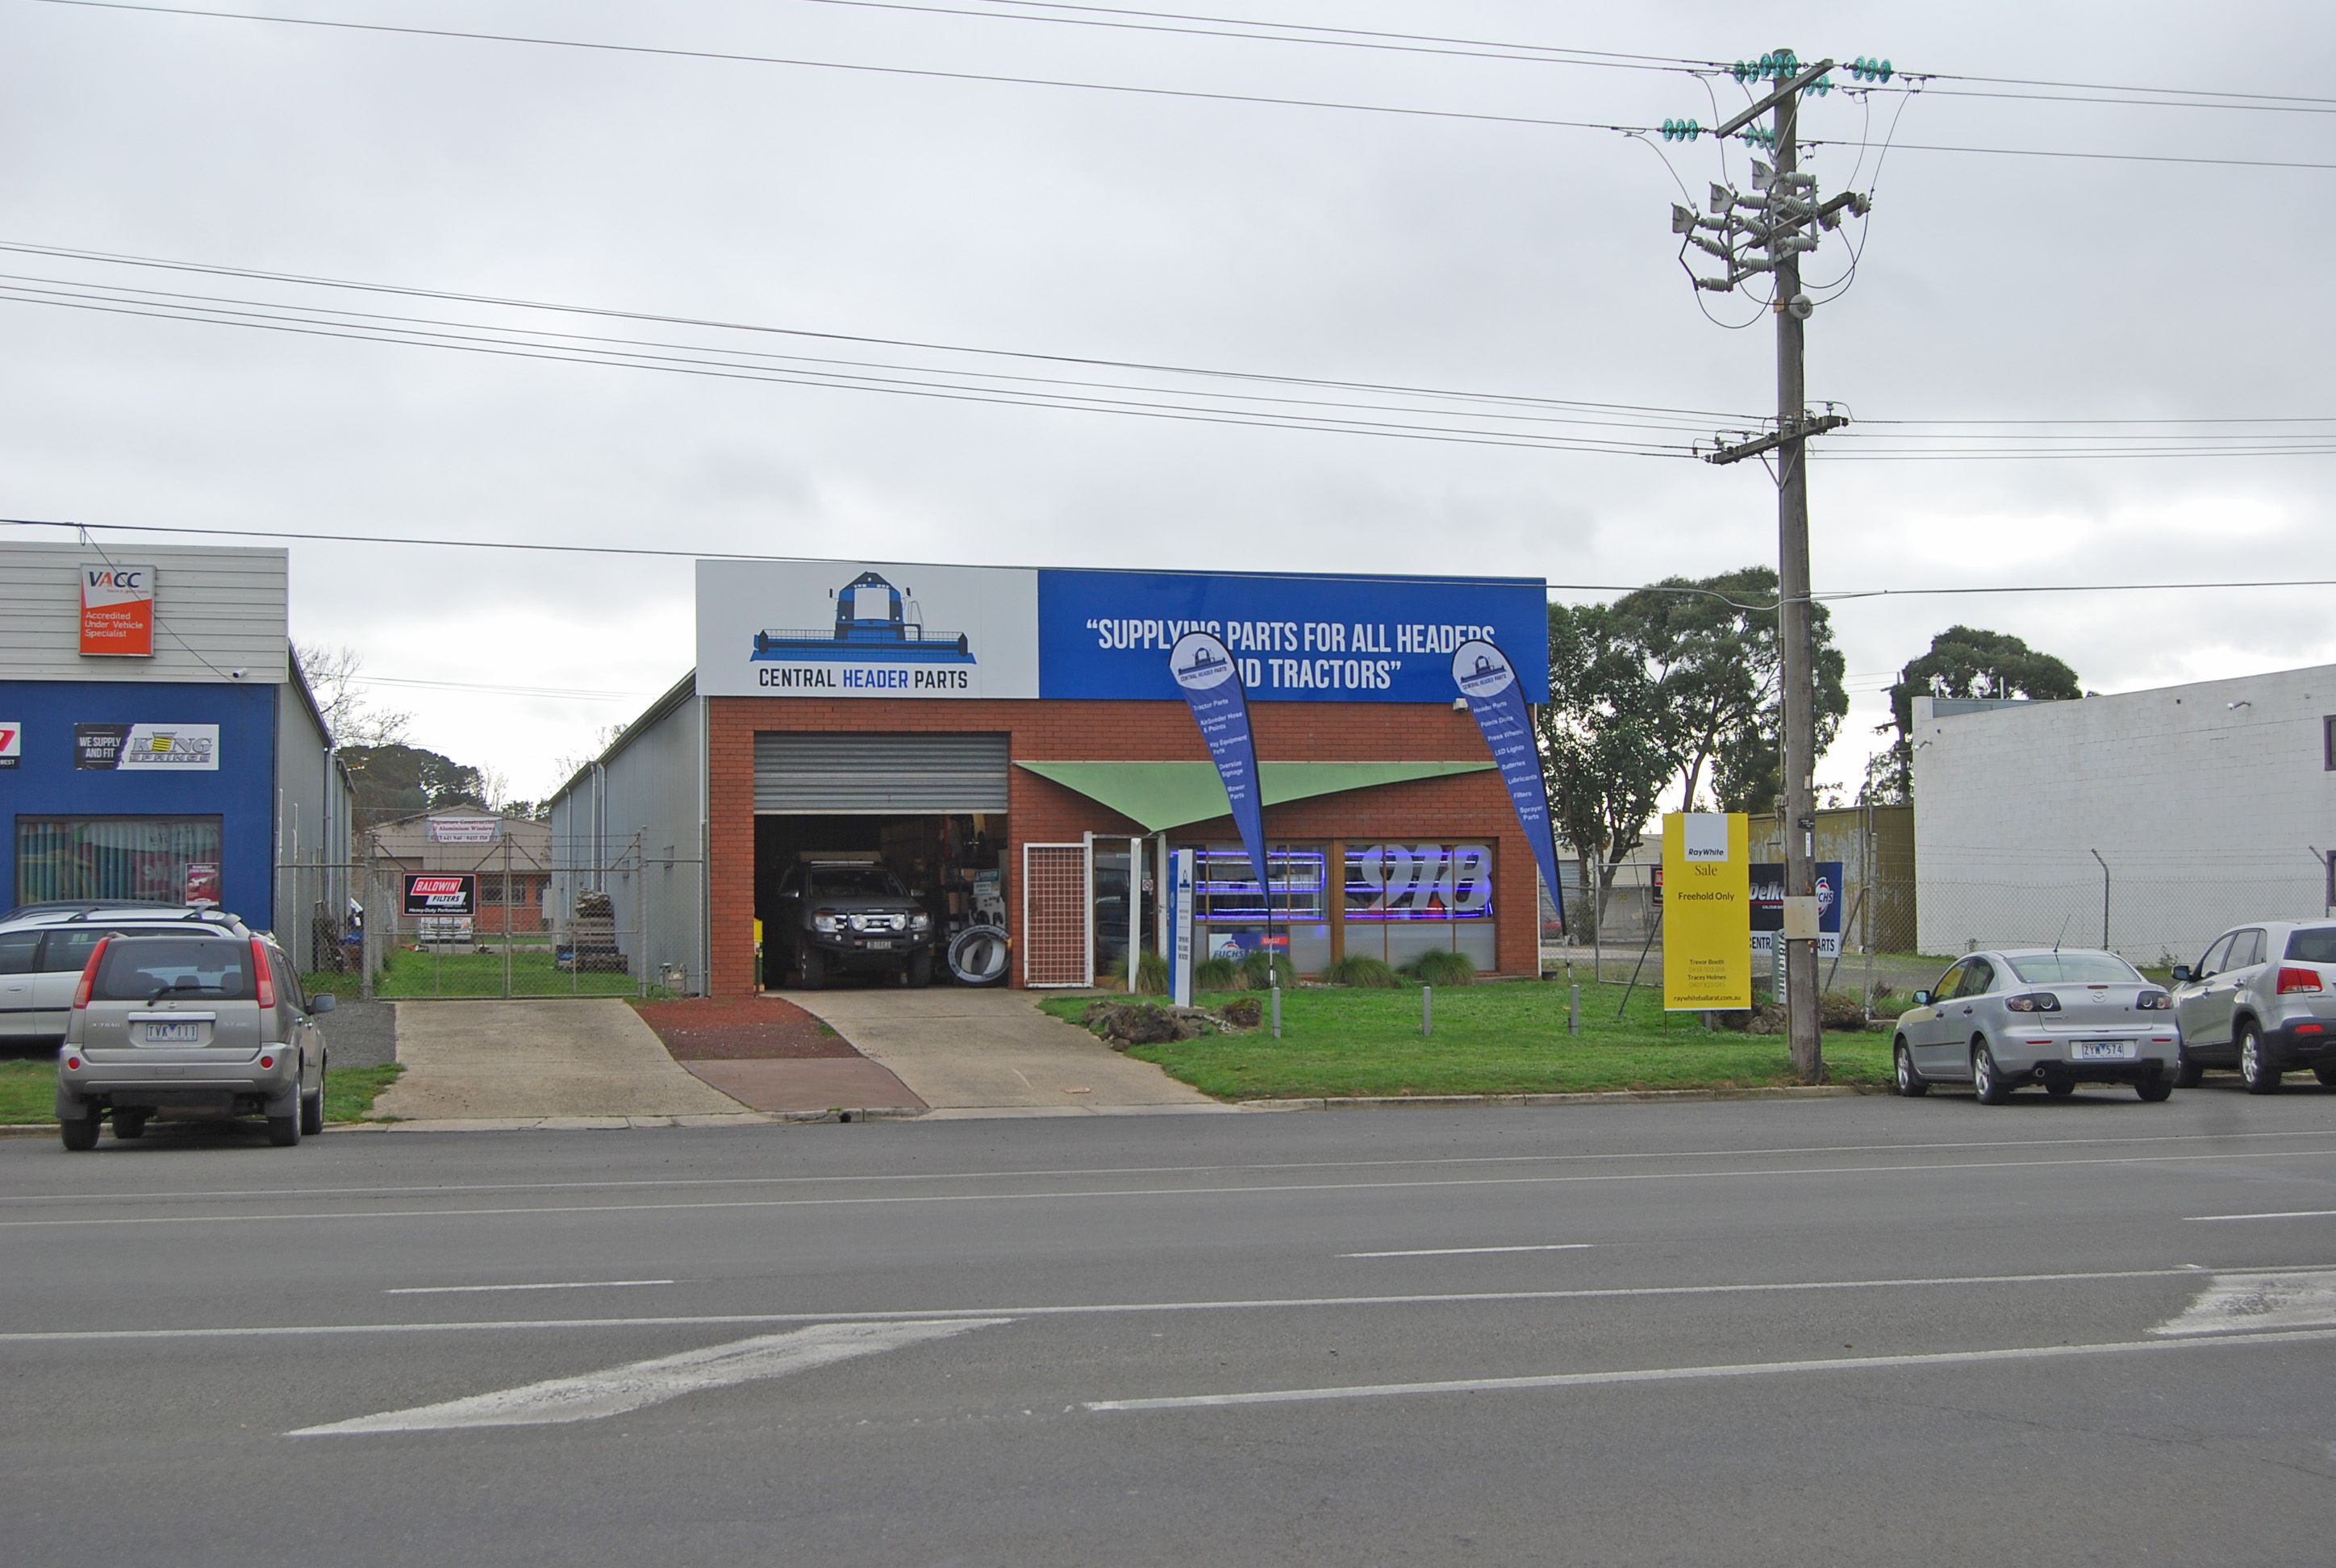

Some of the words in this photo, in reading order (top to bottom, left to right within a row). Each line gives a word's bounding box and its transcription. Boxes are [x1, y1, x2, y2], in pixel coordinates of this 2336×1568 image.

[89, 571, 141, 588] VACC
[86, 611, 131, 619] Accredited
[85, 629, 127, 638] Specialist
[1227, 621, 1298, 651] PARTS
[1304, 623, 1345, 652] FOR
[1351, 623, 1391, 653] ALL
[758, 669, 836, 687] CENTRAL
[843, 669, 908, 689] HEADER
[915, 670, 968, 689] PARTS
[1180, 674, 1198, 682] CENTRAL
[1462, 682, 1479, 690] CENTRAL
[1194, 701, 1212, 711] Tractor
[1213, 699, 1228, 707] Parts
[1473, 705, 1492, 713] Header
[1227, 711, 1243, 719] Hose
[1208, 724, 1226, 732] Points
[79, 736, 92, 747] WE
[93, 736, 122, 747] SUPPLY
[1487, 734, 1504, 742] Press
[86, 748, 102, 758] AND
[103, 748, 115, 758] FIT
[1495, 748, 1506, 757] LED
[1506, 744, 1525, 755] Lights
[1219, 761, 1242, 770] Oversize
[1502, 761, 1526, 770] Batteries
[1508, 774, 1537, 785] Lubricants
[1519, 806, 1543, 815] Sprayer
[1695, 864, 1717, 877] Sale
[1361, 844, 1492, 911] 918
[415, 881, 457, 891] BALDWIN
[1678, 891, 1714, 901] Freehold
[1715, 891, 1735, 902] Only
[1817, 939, 1834, 952] ARTS
[1213, 949, 1245, 958] FUCHS
[148, 1026, 169, 1037] TVK
[177, 1025, 195, 1037] 111
[2106, 1045, 2122, 1055] 574
